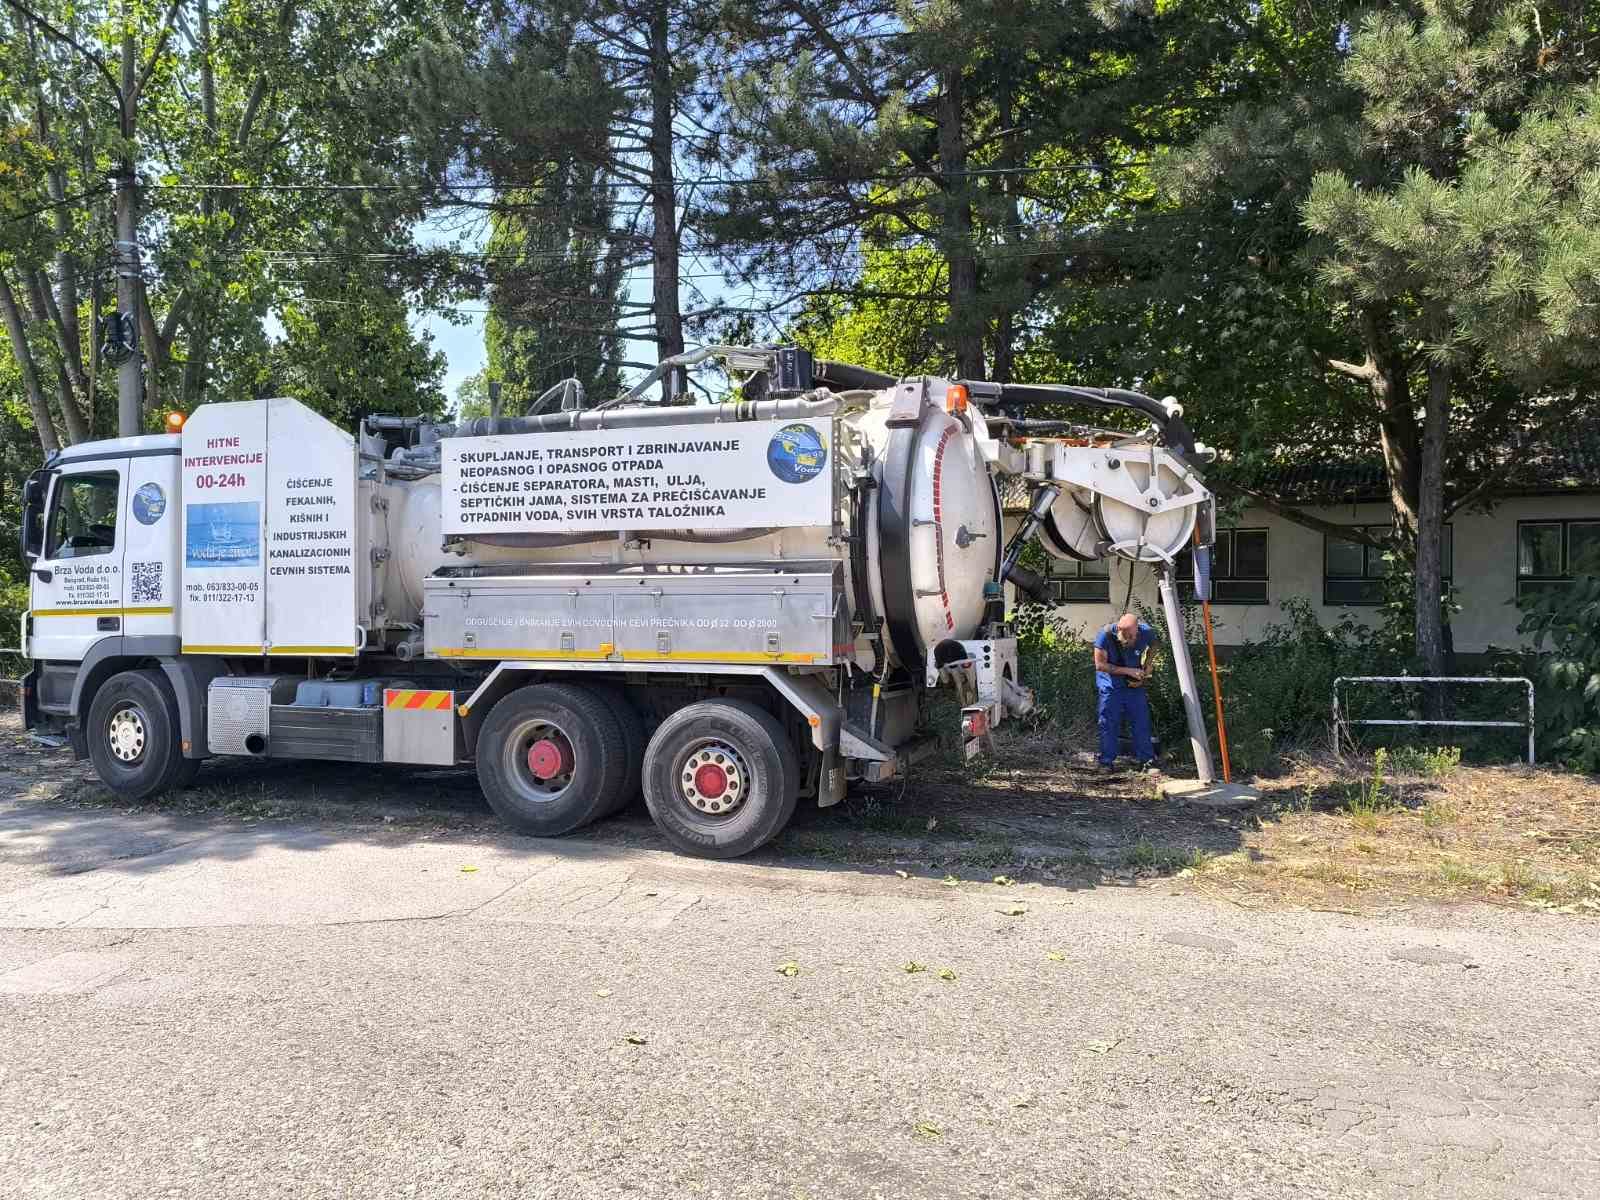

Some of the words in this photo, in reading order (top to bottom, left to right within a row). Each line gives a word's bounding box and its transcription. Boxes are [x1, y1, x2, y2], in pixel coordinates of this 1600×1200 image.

[207, 437, 240, 449] HITNE
[460, 449, 543, 463] SKUPLJANJE,
[547, 446, 624, 459] TRANSPORT
[628, 445, 632, 456] I
[637, 440, 740, 455] ZBRINJAVANJE
[184, 453, 263, 468] INTERVENCIJE
[460, 464, 535, 478] NEOPASNOG
[539, 465, 543, 475] I
[546, 462, 608, 474] OPASNOG
[612, 460, 664, 471] OTPADA
[196, 473, 246, 489] 00-24h
[523, 479, 609, 491] SEPARATORA,
[613, 476, 659, 488] MASTI,
[667, 475, 706, 487] ULJA,
[286, 496, 336, 506] FEKALNIH,
[460, 493, 525, 508] SEPTIČKIH
[528, 495, 567, 507] JAMA,
[570, 493, 628, 505] SISTEMA
[631, 492, 649, 503] ZA
[653, 488, 766, 502] PREČIŠĆAVANJE
[290, 512, 323, 523] KIŠNIH
[326, 513, 329, 522] I
[460, 511, 522, 523] OTPADNIH
[525, 510, 563, 522] VODA,
[566, 509, 597, 520] SVIH
[601, 507, 644, 519] VRSTA
[647, 505, 726, 519] TALOŽNIKA
[273, 530, 347, 541] INDUSTRIJSKIH
[269, 548, 351, 558] KANALIZACIONIH
[54, 565, 72, 575] Brza
[74, 564, 95, 574] Voda
[97, 564, 121, 574] d.o.o.
[270, 567, 305, 576] CEVNIH
[308, 566, 351, 575] SISTEMA
